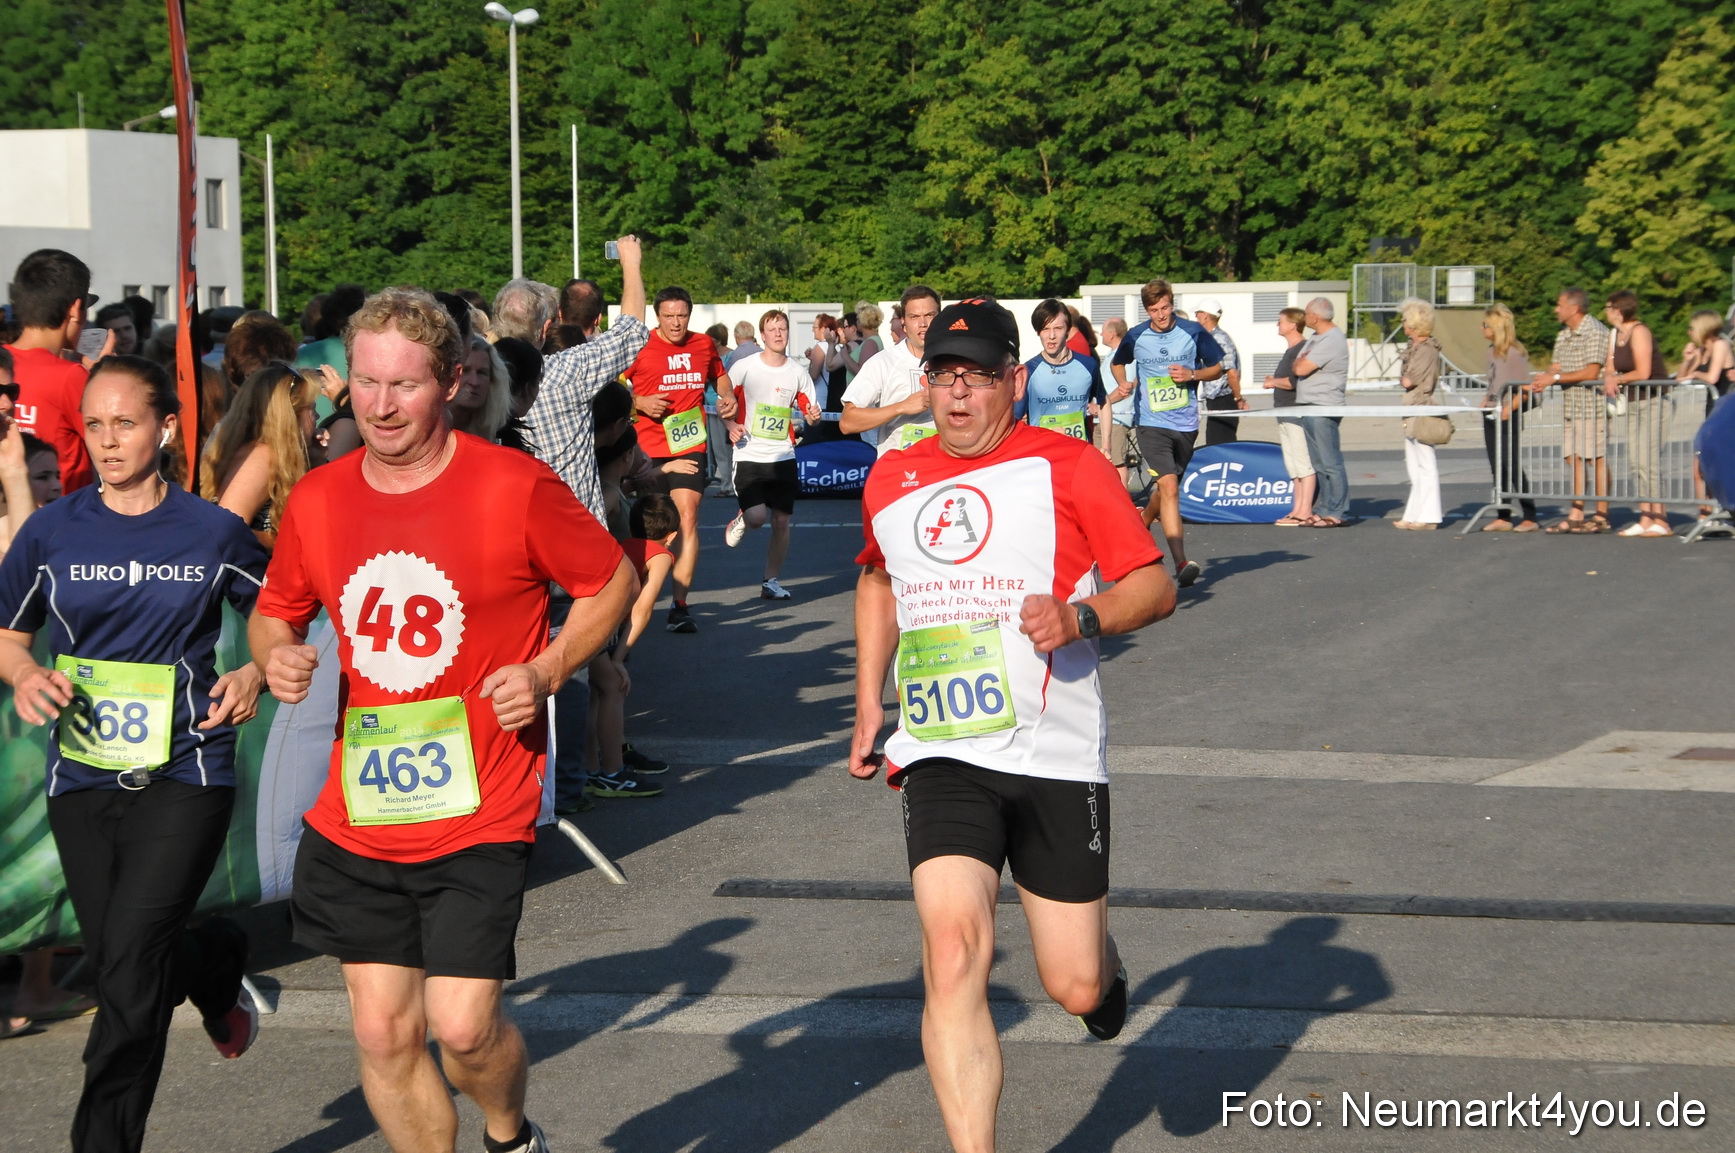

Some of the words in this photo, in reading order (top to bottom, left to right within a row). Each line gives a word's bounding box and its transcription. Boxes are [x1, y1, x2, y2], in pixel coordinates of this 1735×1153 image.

[662, 372, 703, 384] MEIER
[1150, 385, 1185, 403] 1237
[671, 421, 699, 442] 846
[759, 416, 785, 432] 124
[1212, 496, 1293, 507] AUTOMOBILE
[70, 564, 126, 582] EURO
[145, 564, 206, 582] POLES
[900, 580, 943, 598] LAUFEN
[949, 579, 976, 591] MIT
[982, 575, 1025, 591] HERZ
[921, 597, 946, 608] Heck
[910, 610, 1011, 627] Leistungsdiagnostik
[906, 672, 1005, 725] 5106
[70, 695, 149, 744] 368
[356, 724, 398, 736] firmenlauf
[102, 743, 128, 752] Lensch
[358, 741, 452, 794] 463
[385, 796, 412, 804] Richard
[412, 792, 435, 802] Meyer
[377, 804, 424, 814] Hammerbacher
[425, 801, 447, 810] GmbH
